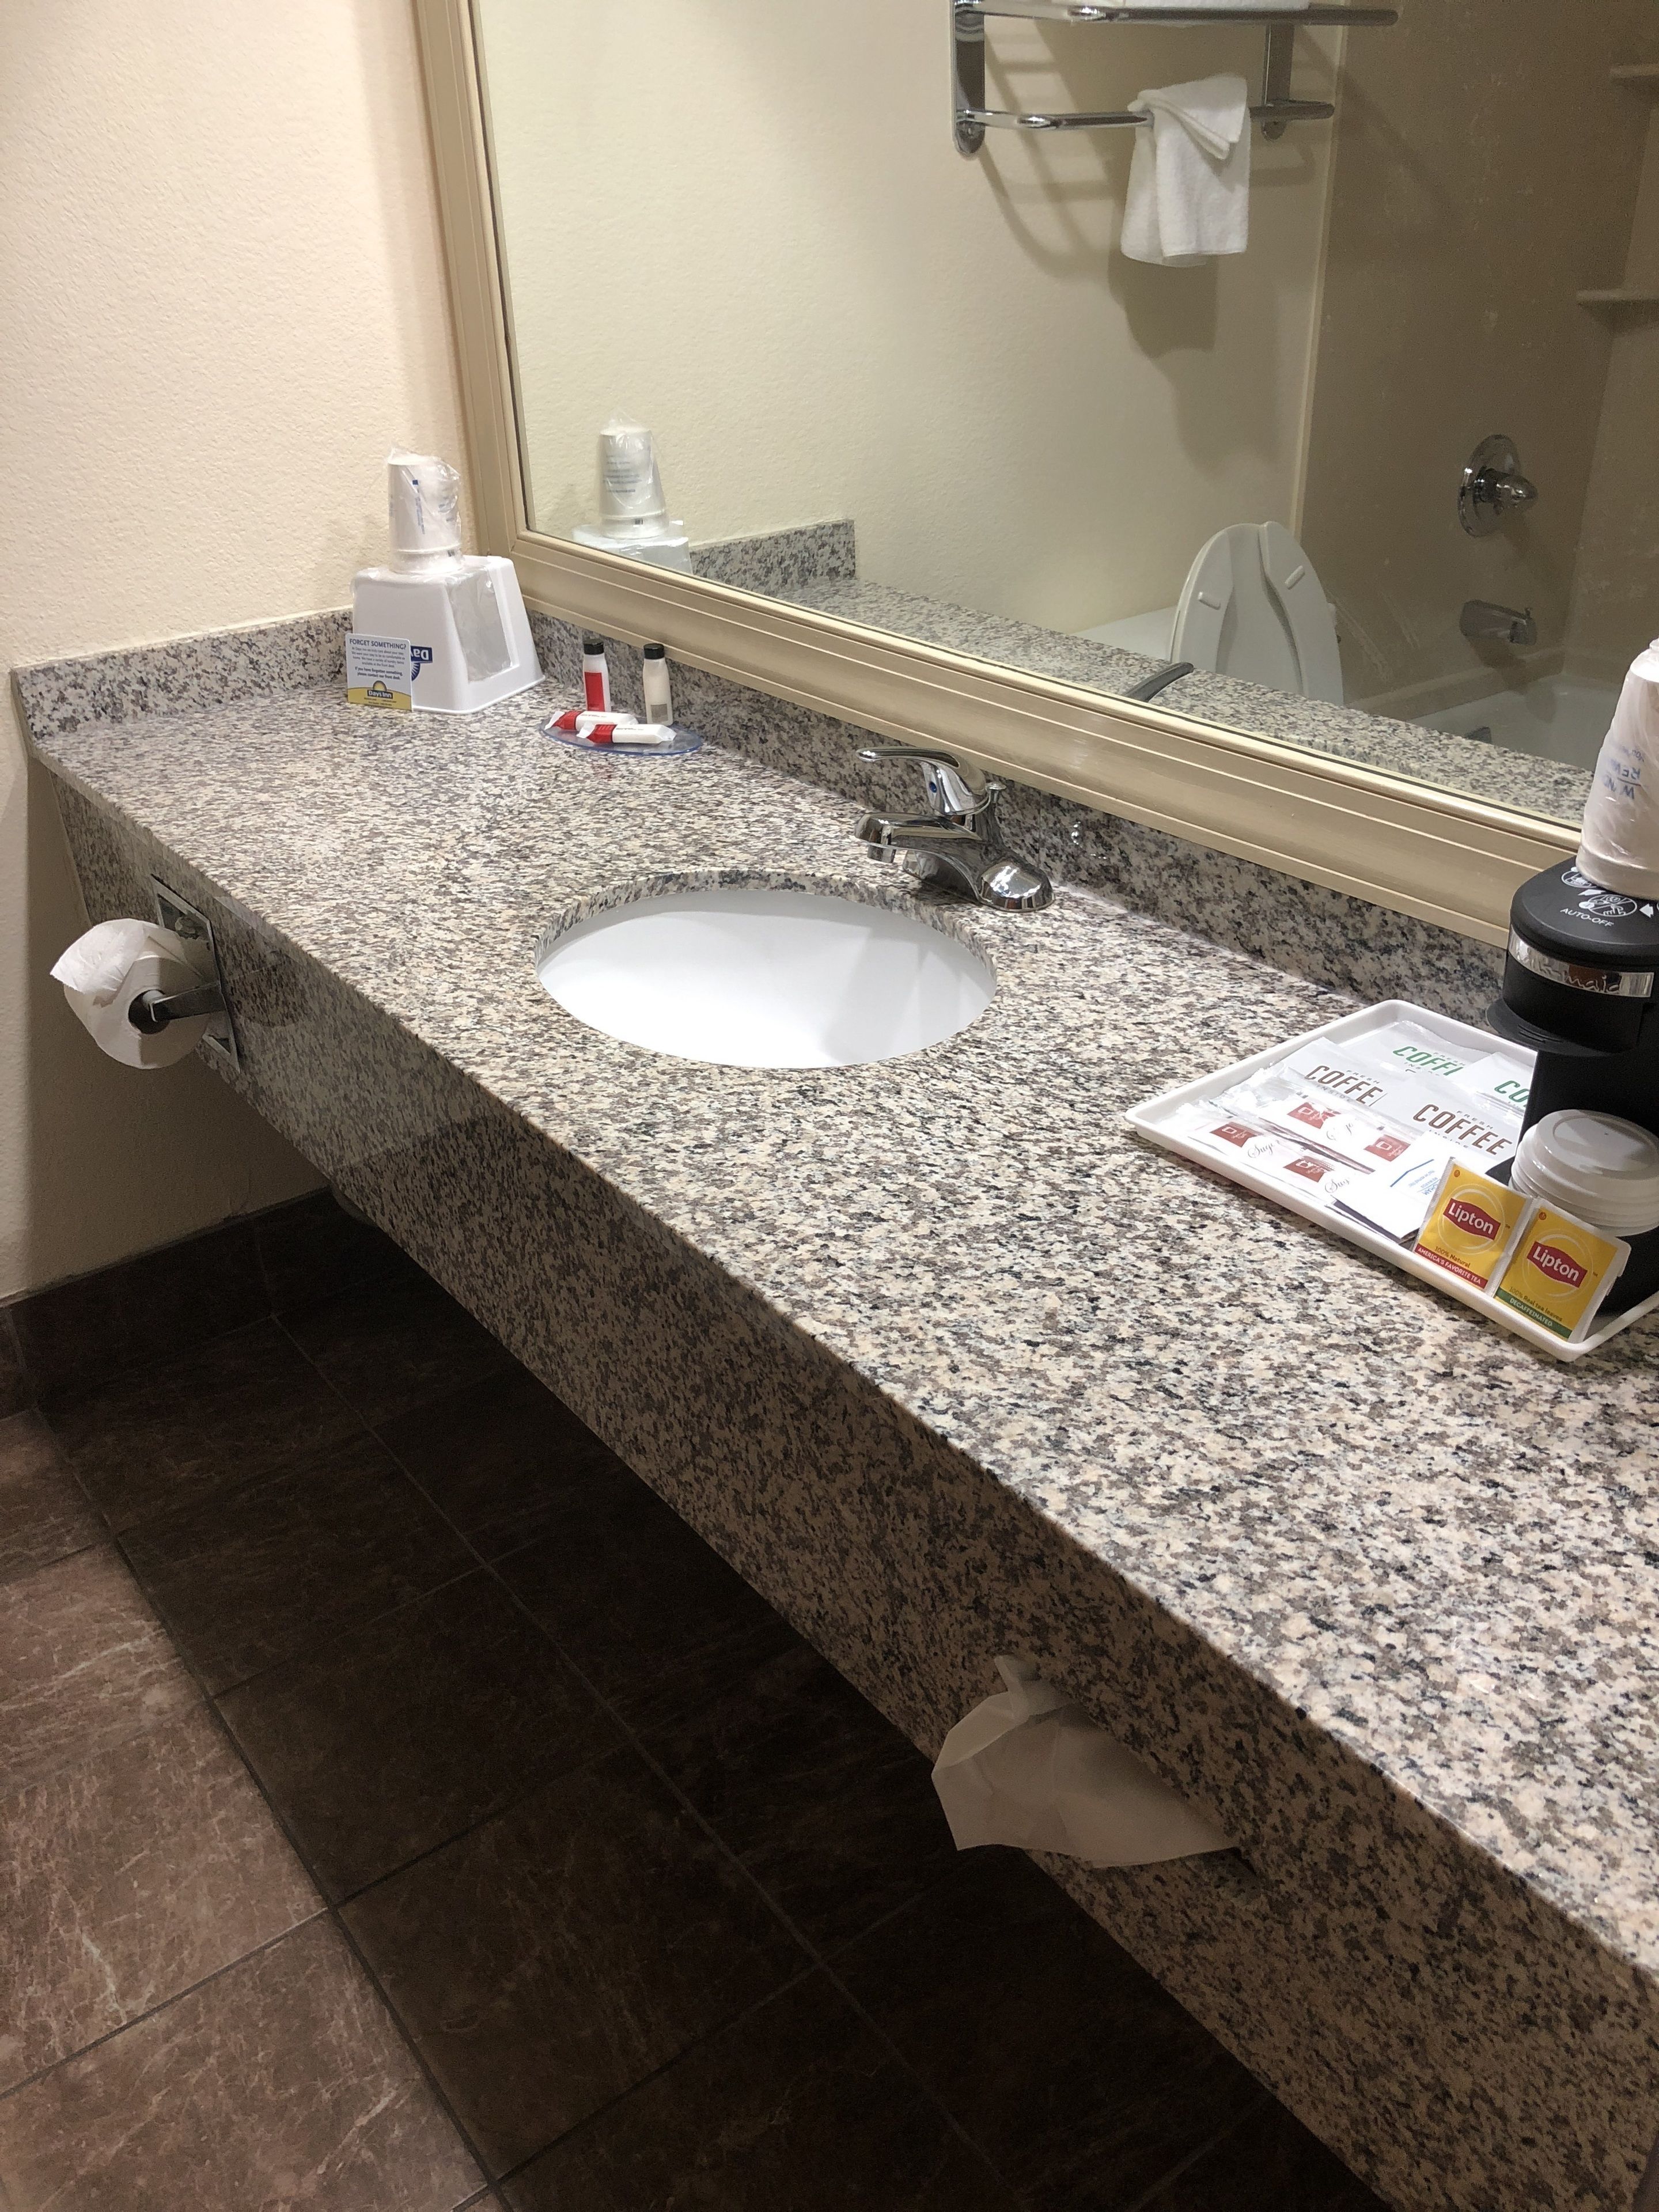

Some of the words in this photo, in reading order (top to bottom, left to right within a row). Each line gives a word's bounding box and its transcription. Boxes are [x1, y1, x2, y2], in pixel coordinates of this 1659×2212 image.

[371, 641, 407, 650] SOMETHING?
[1560, 908, 1614, 927] AUTO-OFF
[1304, 1065, 1388, 1107] COFFE
[1412, 1104, 1513, 1156] COFFEE
[1448, 1202, 1494, 1234] Lipton
[1418, 1247, 1444, 1265] AMERICA'S
[1444, 1260, 1471, 1278] FAVORITE
[1470, 1274, 1481, 1285] TEA
[1434, 1245, 1449, 1258] 100%
[1449, 1253, 1471, 1268] Natural
[1532, 1246, 1580, 1282] Lipton
[1509, 1297, 1553, 1327] DECAFFEINATED
[1524, 1296, 1536, 1306] Real
[1535, 1301, 1544, 1312] tea
[1545, 1307, 1563, 1321] leaves
